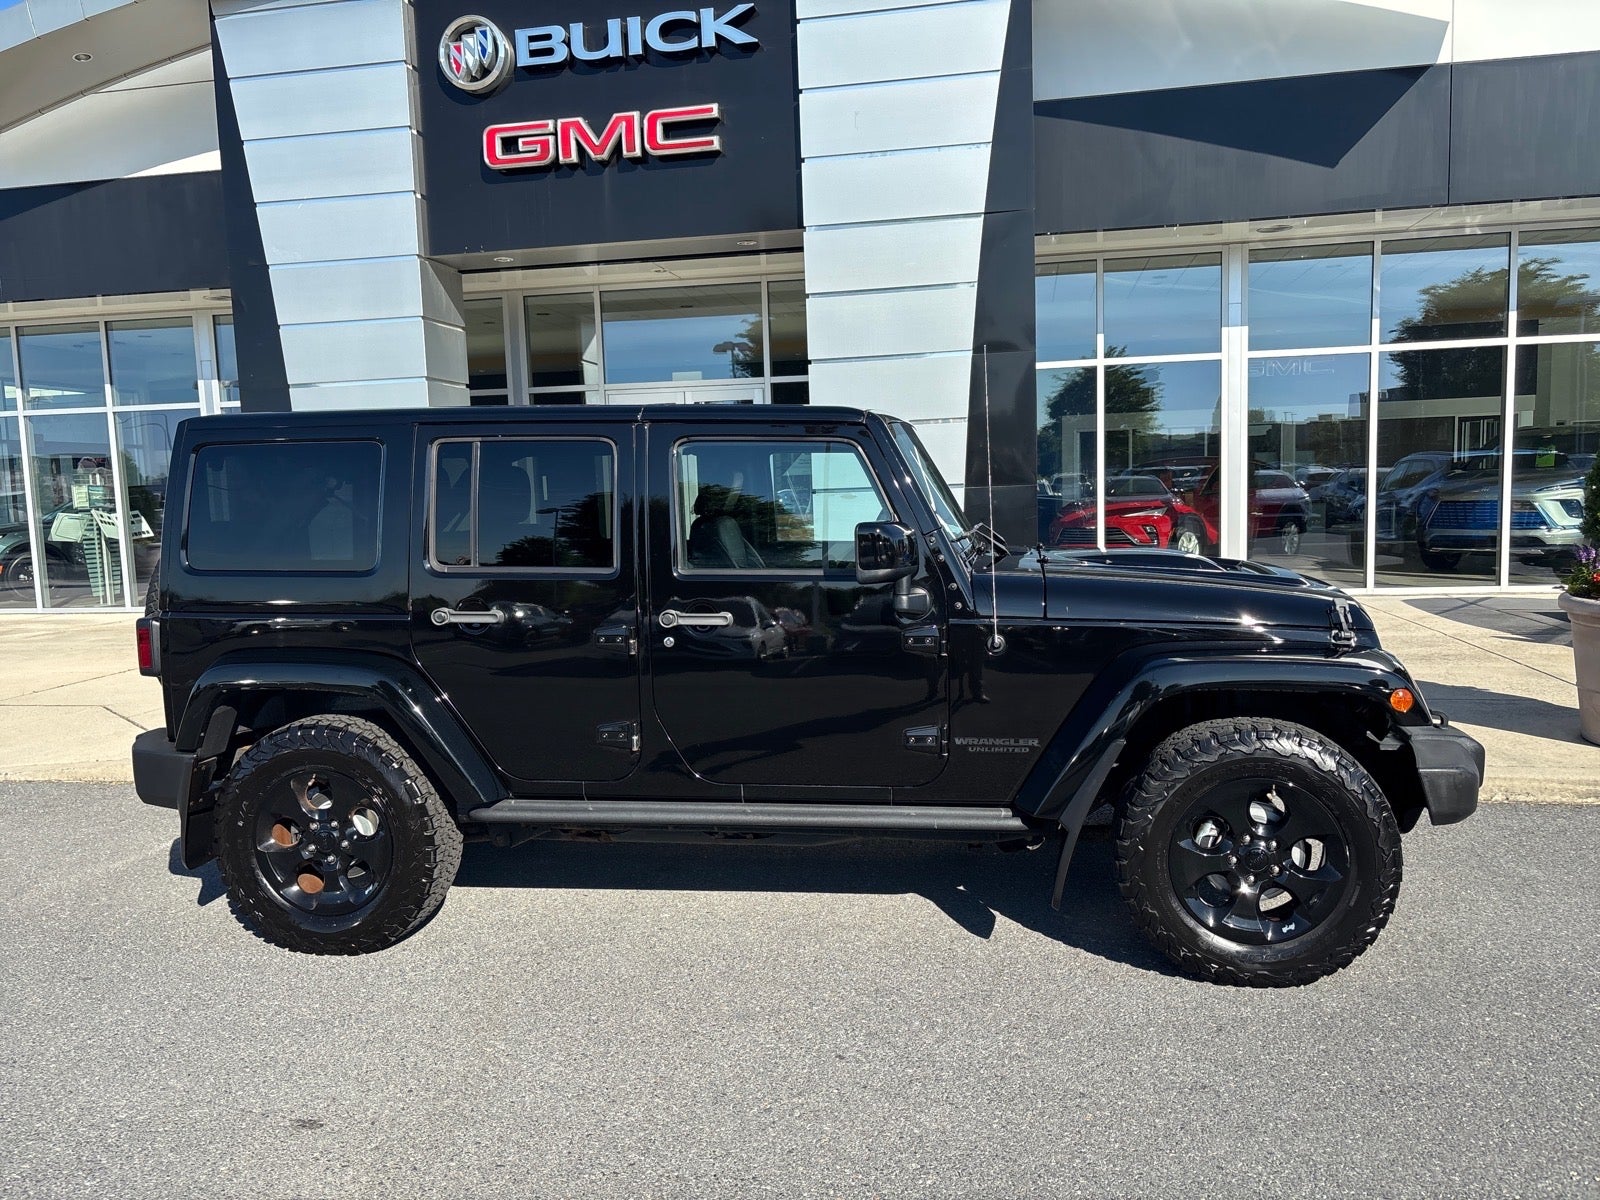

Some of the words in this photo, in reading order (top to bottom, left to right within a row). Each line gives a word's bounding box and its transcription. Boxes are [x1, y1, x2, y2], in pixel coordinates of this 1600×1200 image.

[514, 3, 758, 67] BUICK
[482, 102, 722, 171] GMC
[954, 737, 1040, 746] WRANGLER
